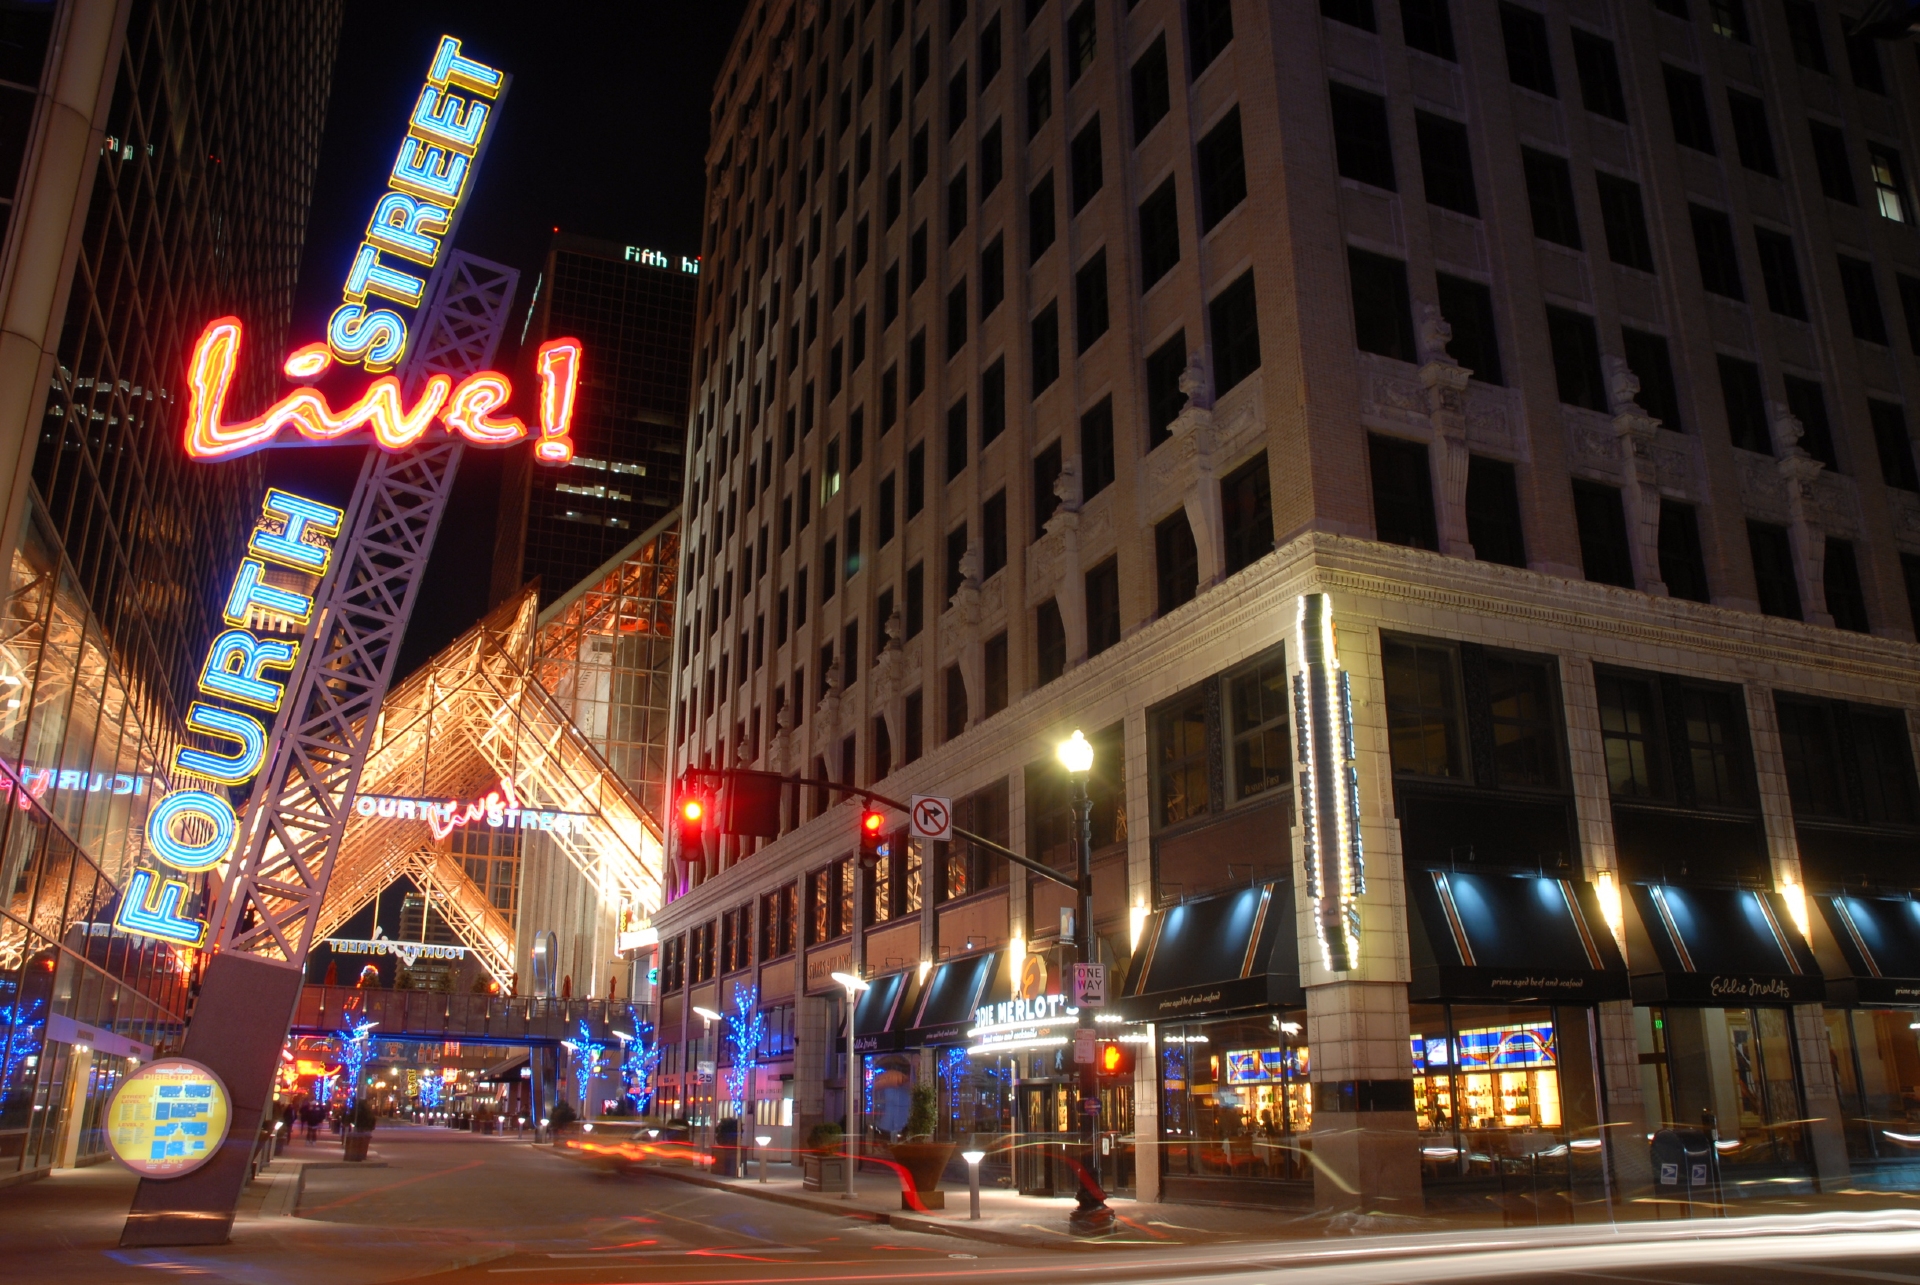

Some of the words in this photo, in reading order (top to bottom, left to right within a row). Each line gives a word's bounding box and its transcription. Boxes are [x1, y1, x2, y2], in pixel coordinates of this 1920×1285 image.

[624, 245, 668, 268] Fifth
[184, 315, 582, 466] Live!
[114, 486, 345, 949] FOURTH
[327, 34, 504, 374] STREET
[356, 796, 452, 823] OURTH
[485, 807, 589, 835] STREET
[1077, 968, 1102, 978] ONE
[1491, 977, 1512, 987] prime
[1513, 977, 1529, 988] aged
[1530, 977, 1545, 988] beef
[1545, 977, 1558, 987] and
[1077, 980, 1102, 990] WAY
[1711, 976, 1747, 996] Eddie
[699, 1073, 712, 1082] 25
